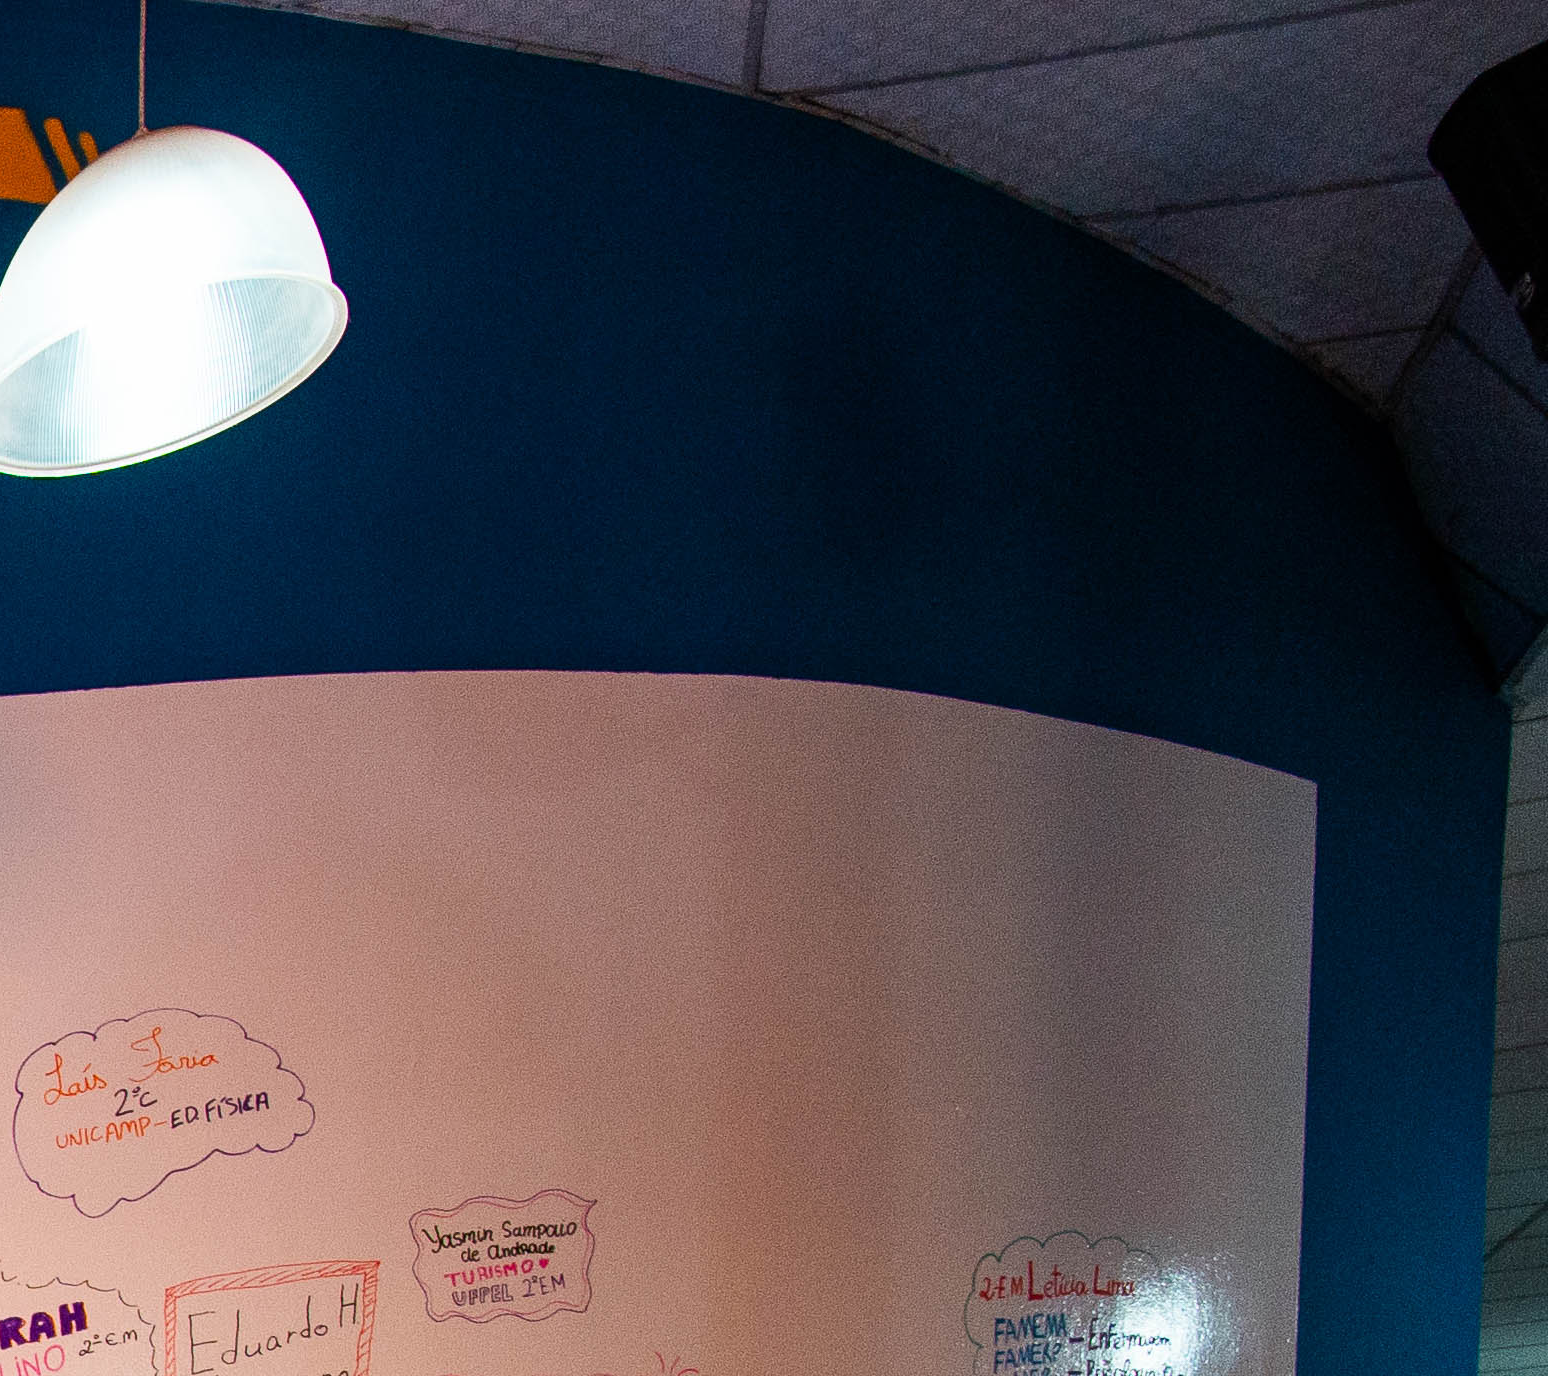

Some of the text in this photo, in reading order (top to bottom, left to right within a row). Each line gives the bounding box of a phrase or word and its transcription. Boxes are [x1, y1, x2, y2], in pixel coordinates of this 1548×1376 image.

[422, 1225, 494, 1254] Yasmin
[445, 1259, 534, 1287] TURISMO
[189, 1295, 328, 1375] Eduardo
